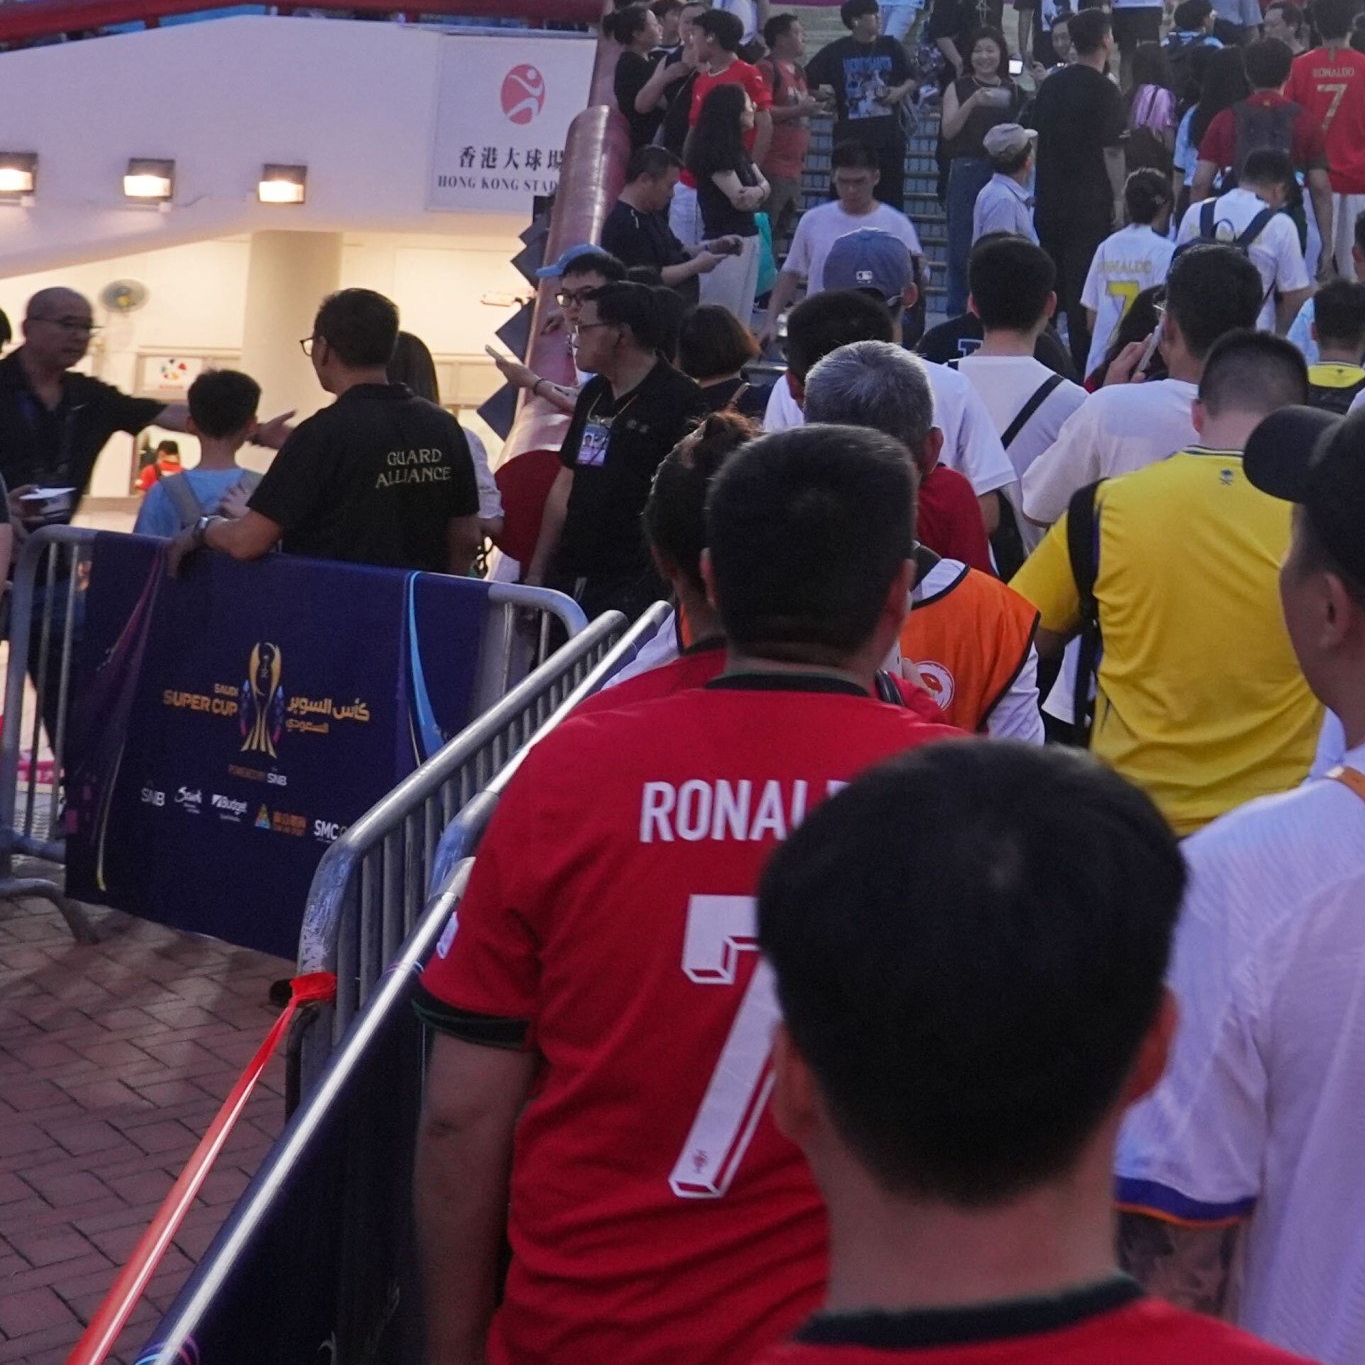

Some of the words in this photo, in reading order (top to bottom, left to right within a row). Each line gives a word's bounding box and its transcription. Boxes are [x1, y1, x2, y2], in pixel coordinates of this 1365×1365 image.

[1312, 67, 1355, 79] RONALDO
[1316, 84, 1348, 131] 7
[438, 175, 476, 189] HONG
[481, 176, 519, 190] KONG
[1106, 281, 1140, 343] 7
[386, 448, 442, 466] GUARD
[375, 466, 452, 489] ALLIANCE
[163, 689, 210, 712] SUPER
[211, 698, 238, 716] CUP
[332, 697, 371, 722] كأس
[267, 772, 288, 786] SNB
[141, 787, 166, 807] SNB
[313, 819, 339, 840] SMC
[667, 893, 788, 1200] 7
